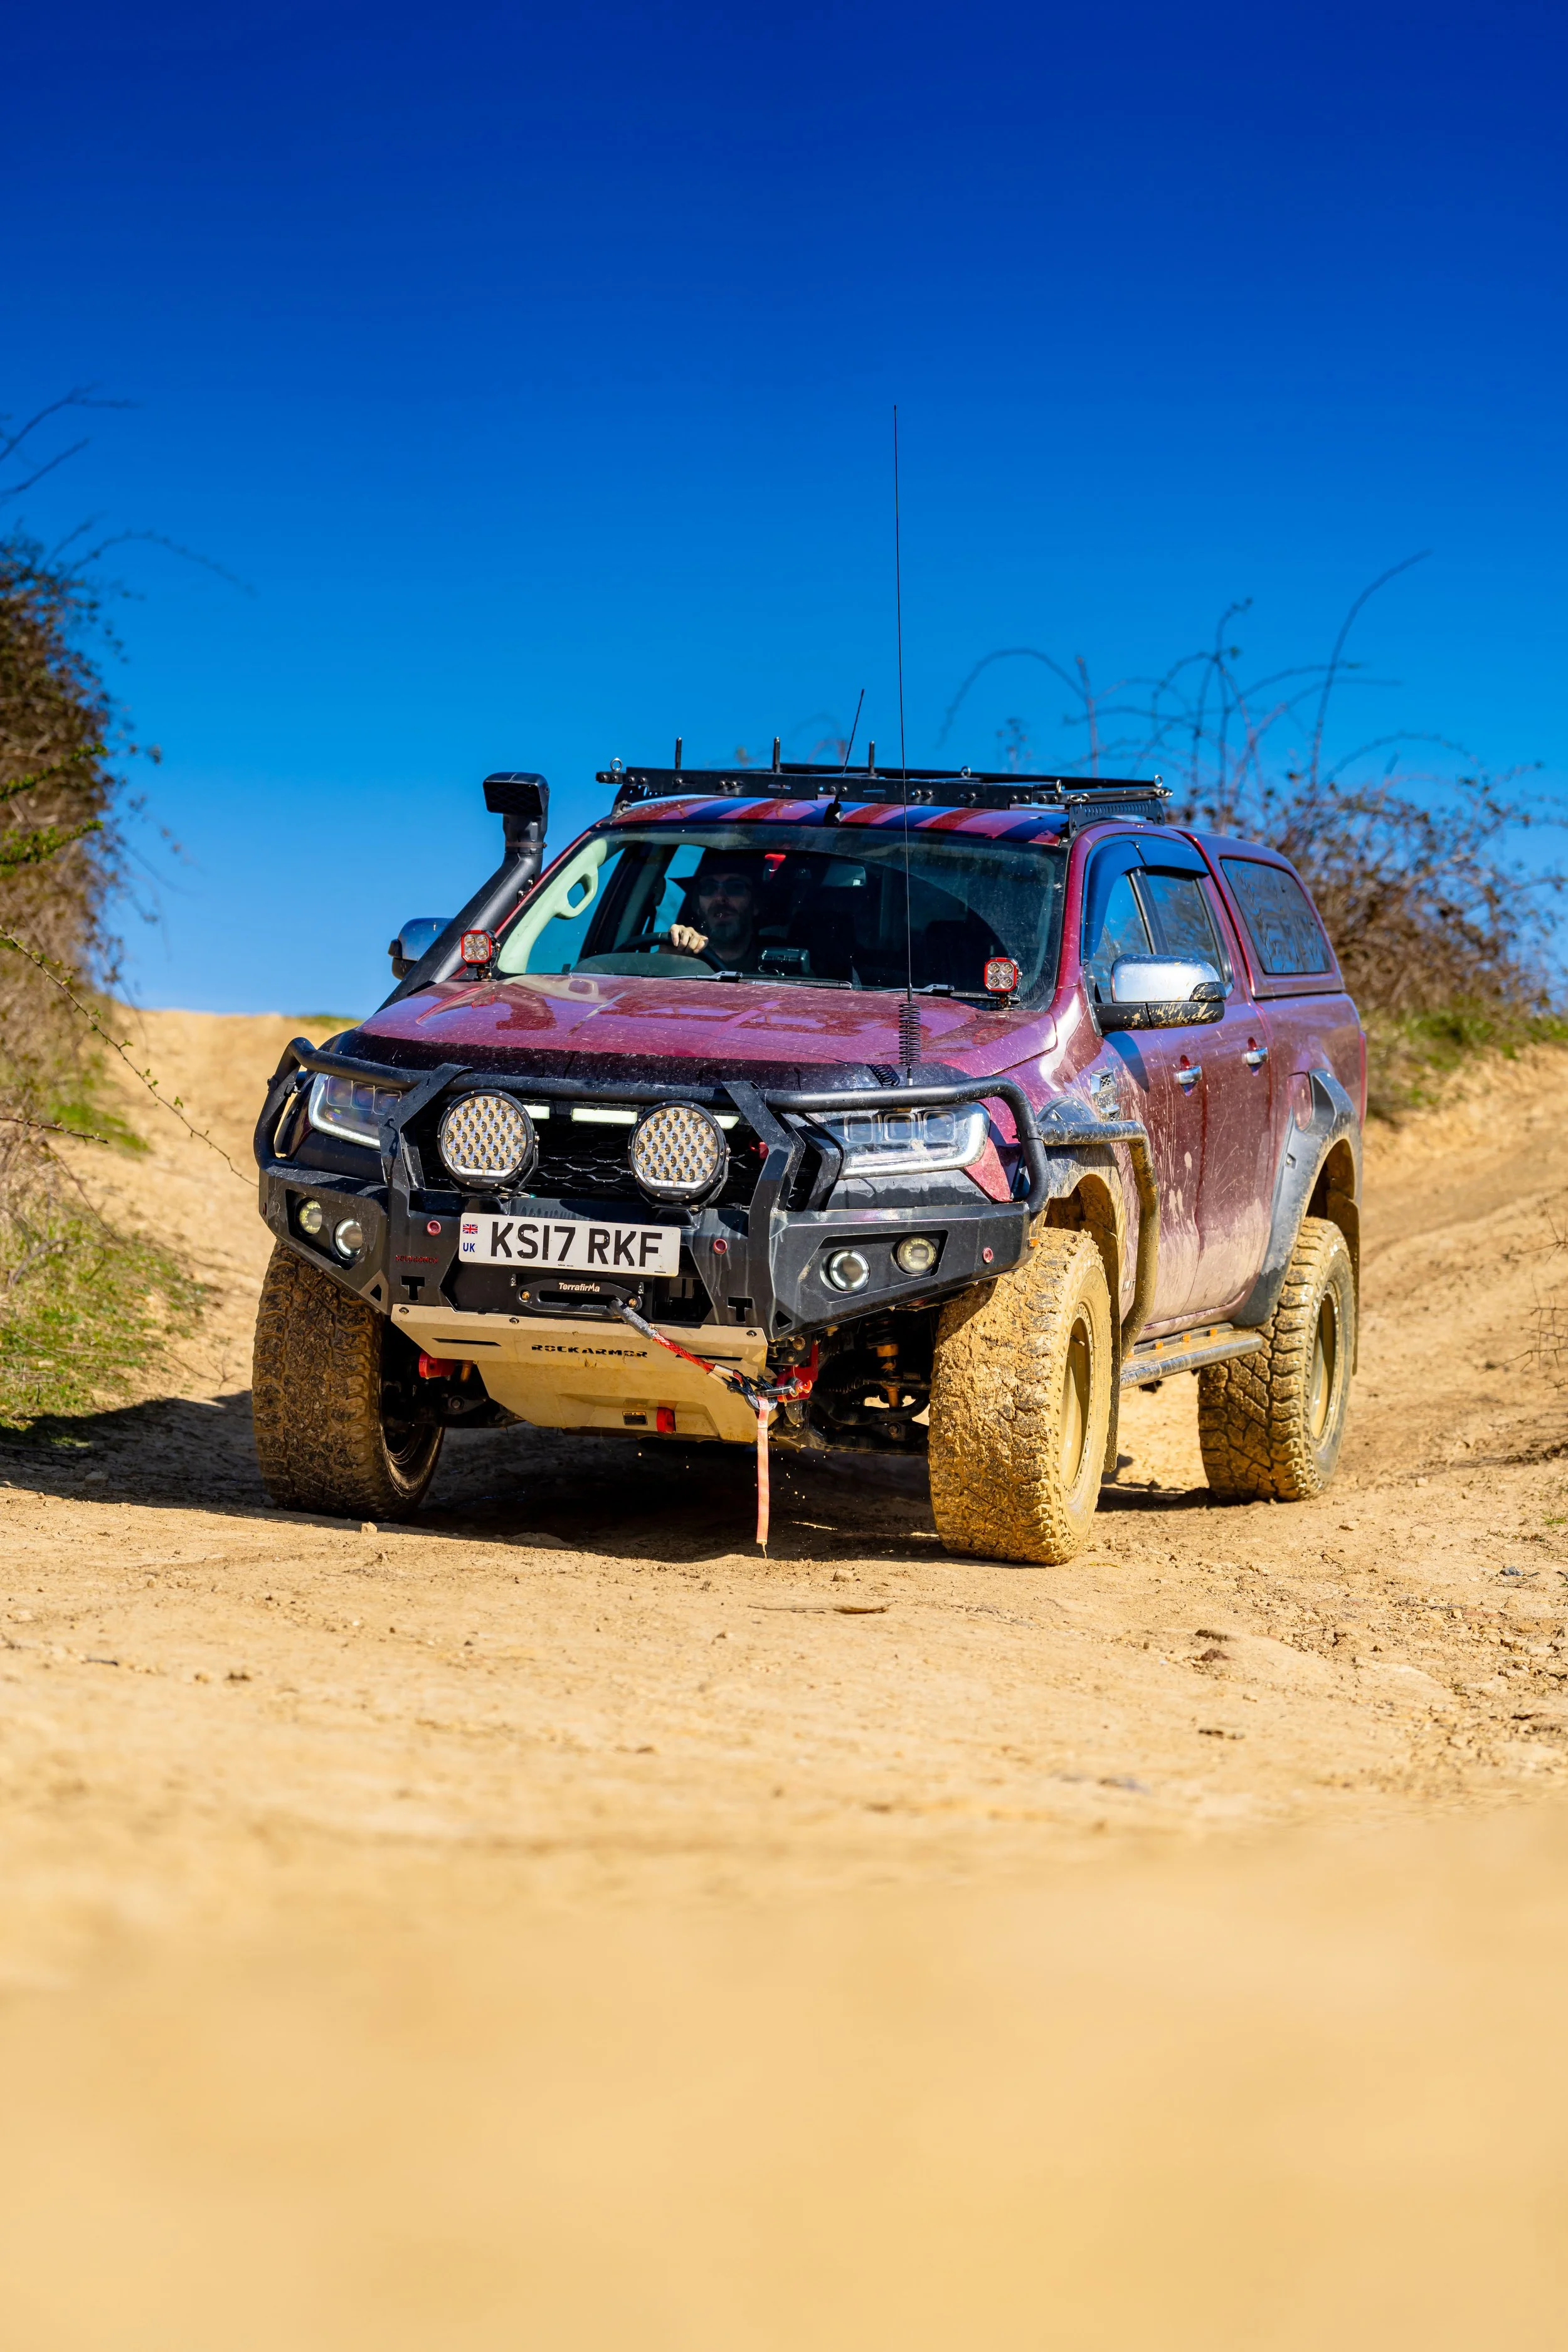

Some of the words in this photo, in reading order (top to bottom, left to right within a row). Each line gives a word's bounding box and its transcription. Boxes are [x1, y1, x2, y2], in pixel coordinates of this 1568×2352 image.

[463, 1242, 475, 1253] UK
[490, 1221, 576, 1262] KS17
[587, 1227, 662, 1268] RKF
[531, 1344, 648, 1358] ROCKARMOR
